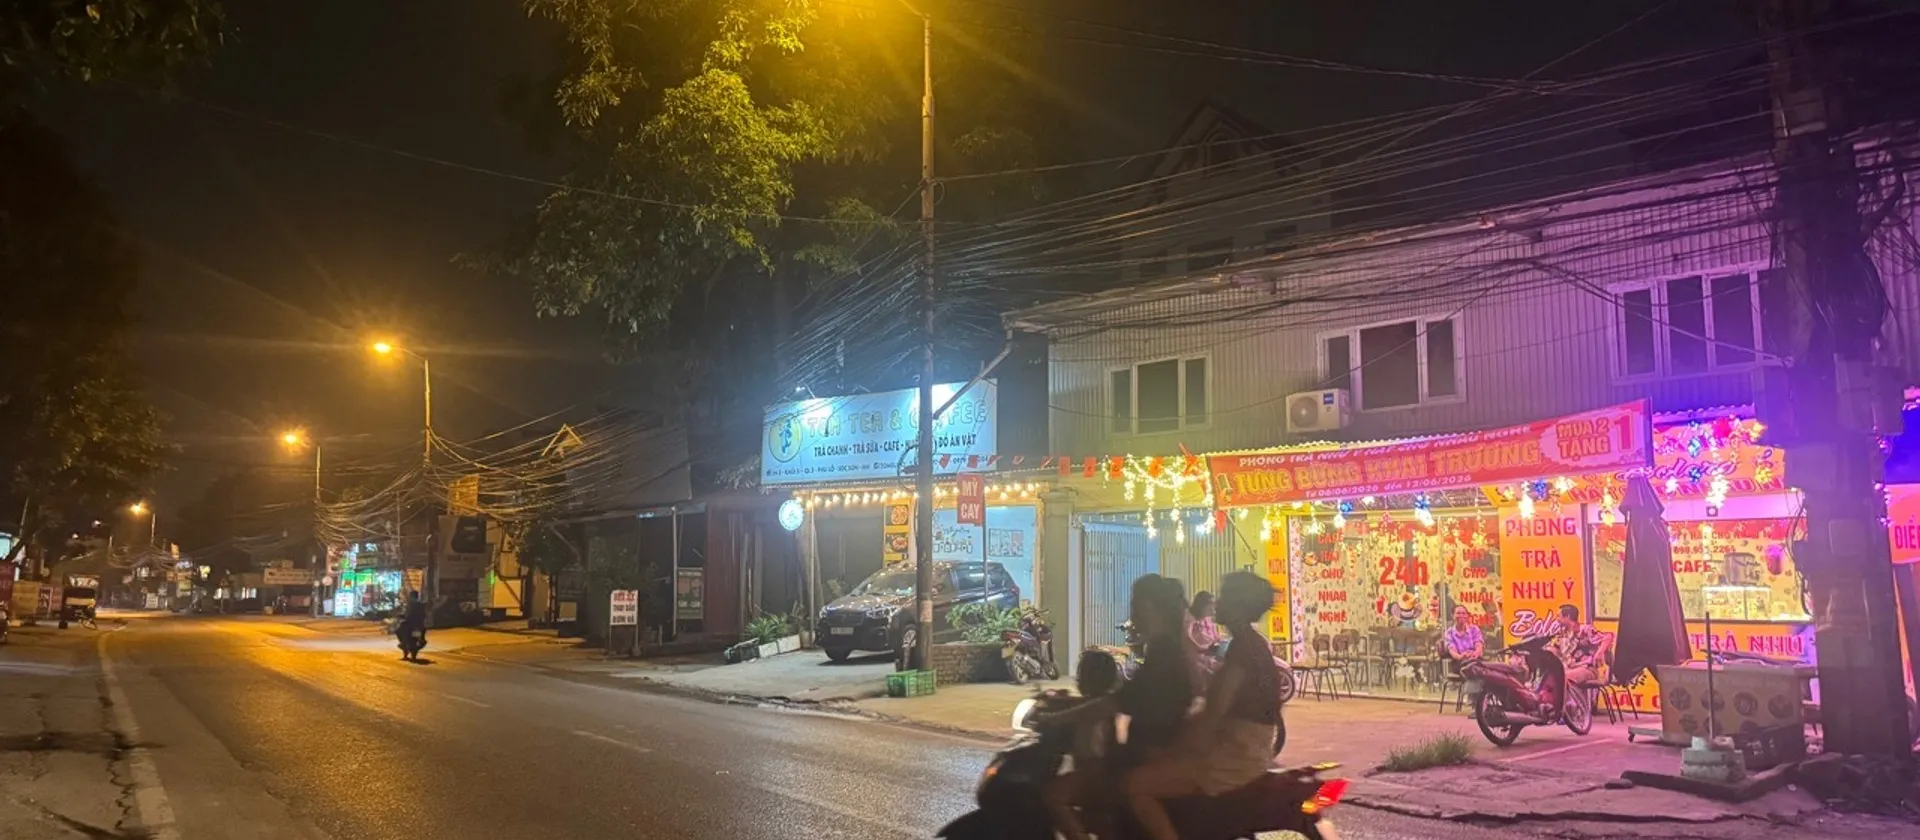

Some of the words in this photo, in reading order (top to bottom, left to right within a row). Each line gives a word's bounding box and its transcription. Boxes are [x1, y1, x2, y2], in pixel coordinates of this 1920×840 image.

[1556, 420, 1594, 438] MUA
[1596, 417, 1609, 434] 2
[1558, 437, 1610, 461] TẶNG
[1406, 474, 1472, 489] 12/06/2026
[961, 503, 980, 519] CAY
[1521, 544, 1561, 569] TRÀ
[1379, 556, 1429, 586] 24h
[1460, 591, 1493, 603] NHAU
[1512, 579, 1555, 599] NHƯ
[1563, 576, 1574, 599] Ý
